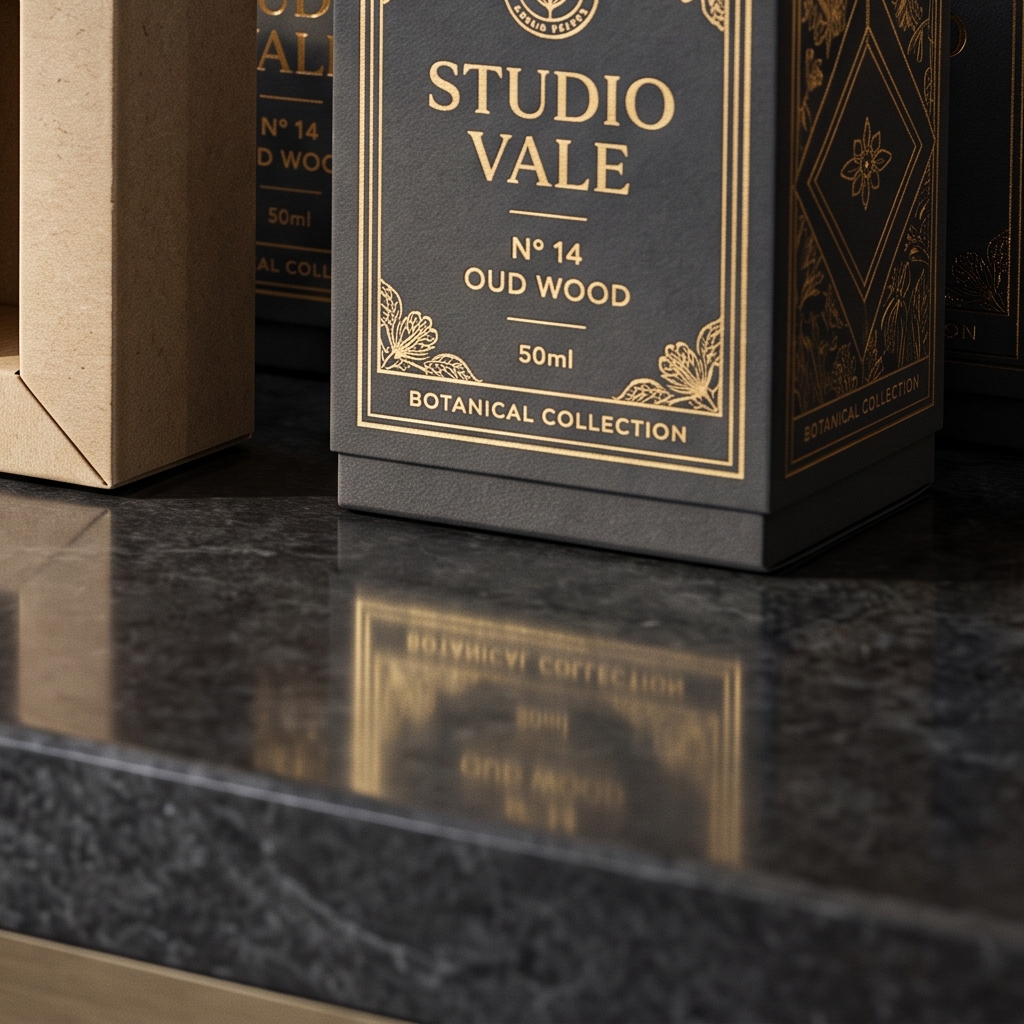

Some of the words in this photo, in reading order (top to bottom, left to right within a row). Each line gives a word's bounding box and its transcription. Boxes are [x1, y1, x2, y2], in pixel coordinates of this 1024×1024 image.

[428, 60, 676, 131] STUDIO
[295, 120, 319, 141] 14
[280, 150, 333, 174] WOO
[466, 129, 631, 196] VALE
[268, 207, 312, 227] 50ml
[553, 241, 583, 266] 14
[285, 260, 332, 279] COLL
[463, 266, 527, 296] OUD
[535, 274, 632, 308] WOOD
[518, 344, 574, 369] 50ml
[408, 389, 535, 423] BOTANICAL
[541, 407, 688, 444] COLLECTION
[803, 404, 860, 443] BOTANICAL
[862, 374, 920, 414] COLLECTION
